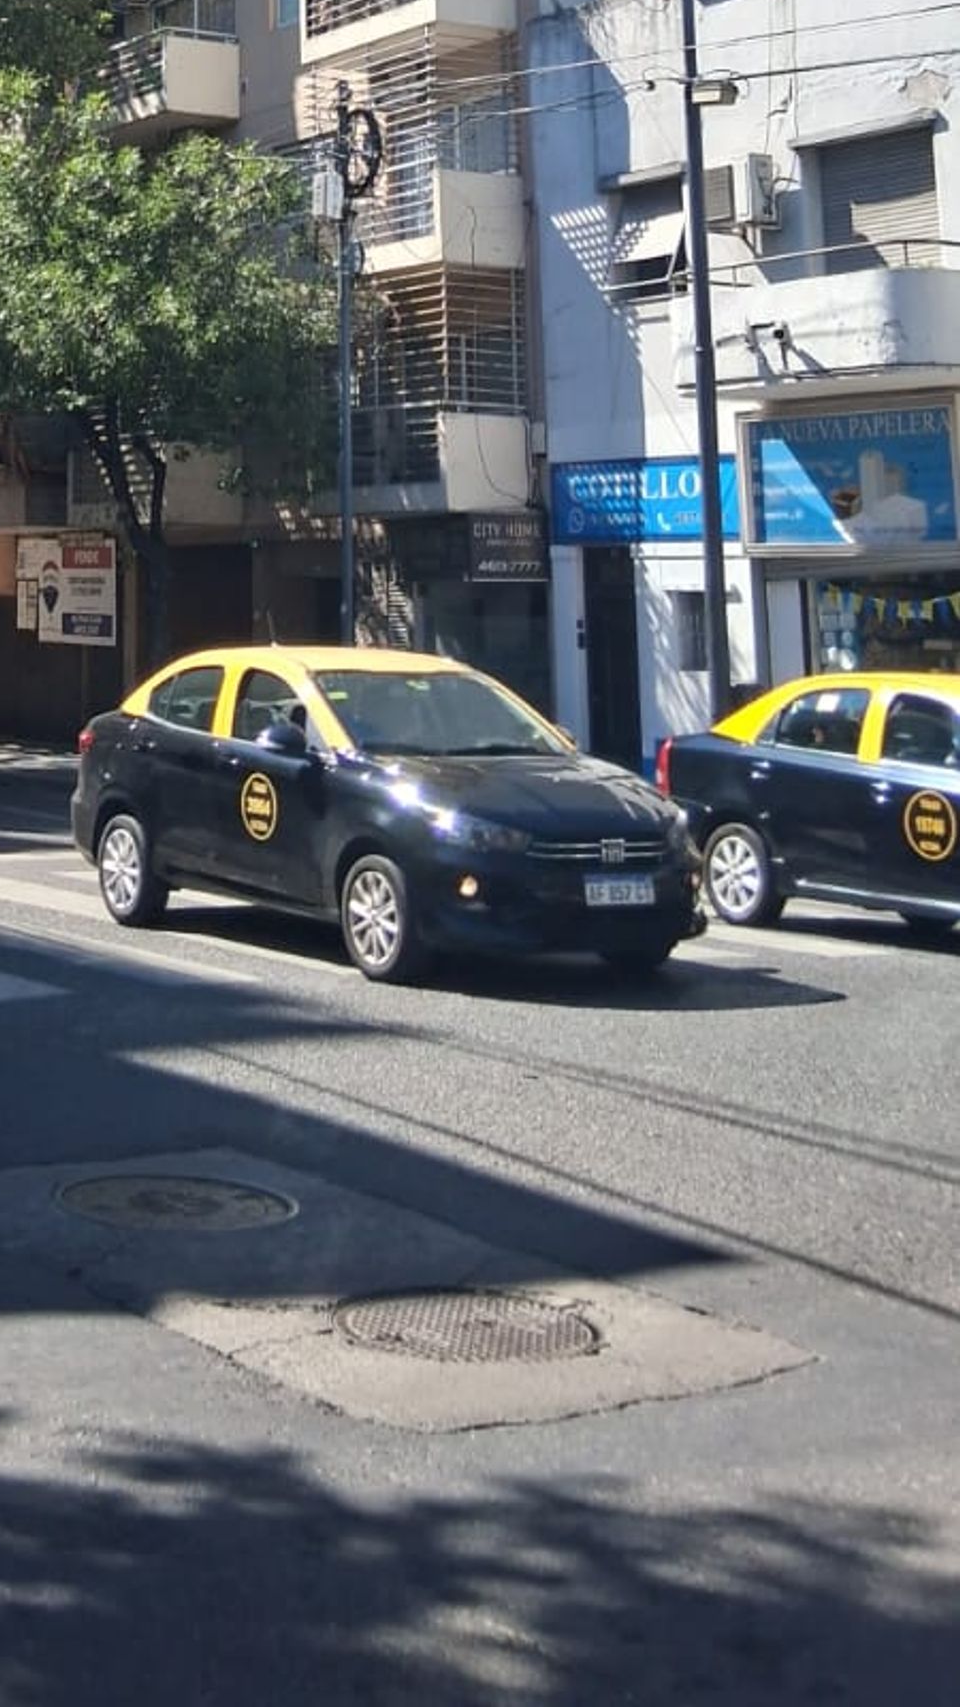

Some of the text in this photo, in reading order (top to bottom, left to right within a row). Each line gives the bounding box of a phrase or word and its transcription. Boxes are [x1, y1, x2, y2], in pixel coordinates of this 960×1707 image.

[779, 420, 845, 442] NUEVA
[848, 408, 953, 438] PAPELERA
[568, 468, 702, 502] COTILLO
[473, 522, 500, 538] CITY
